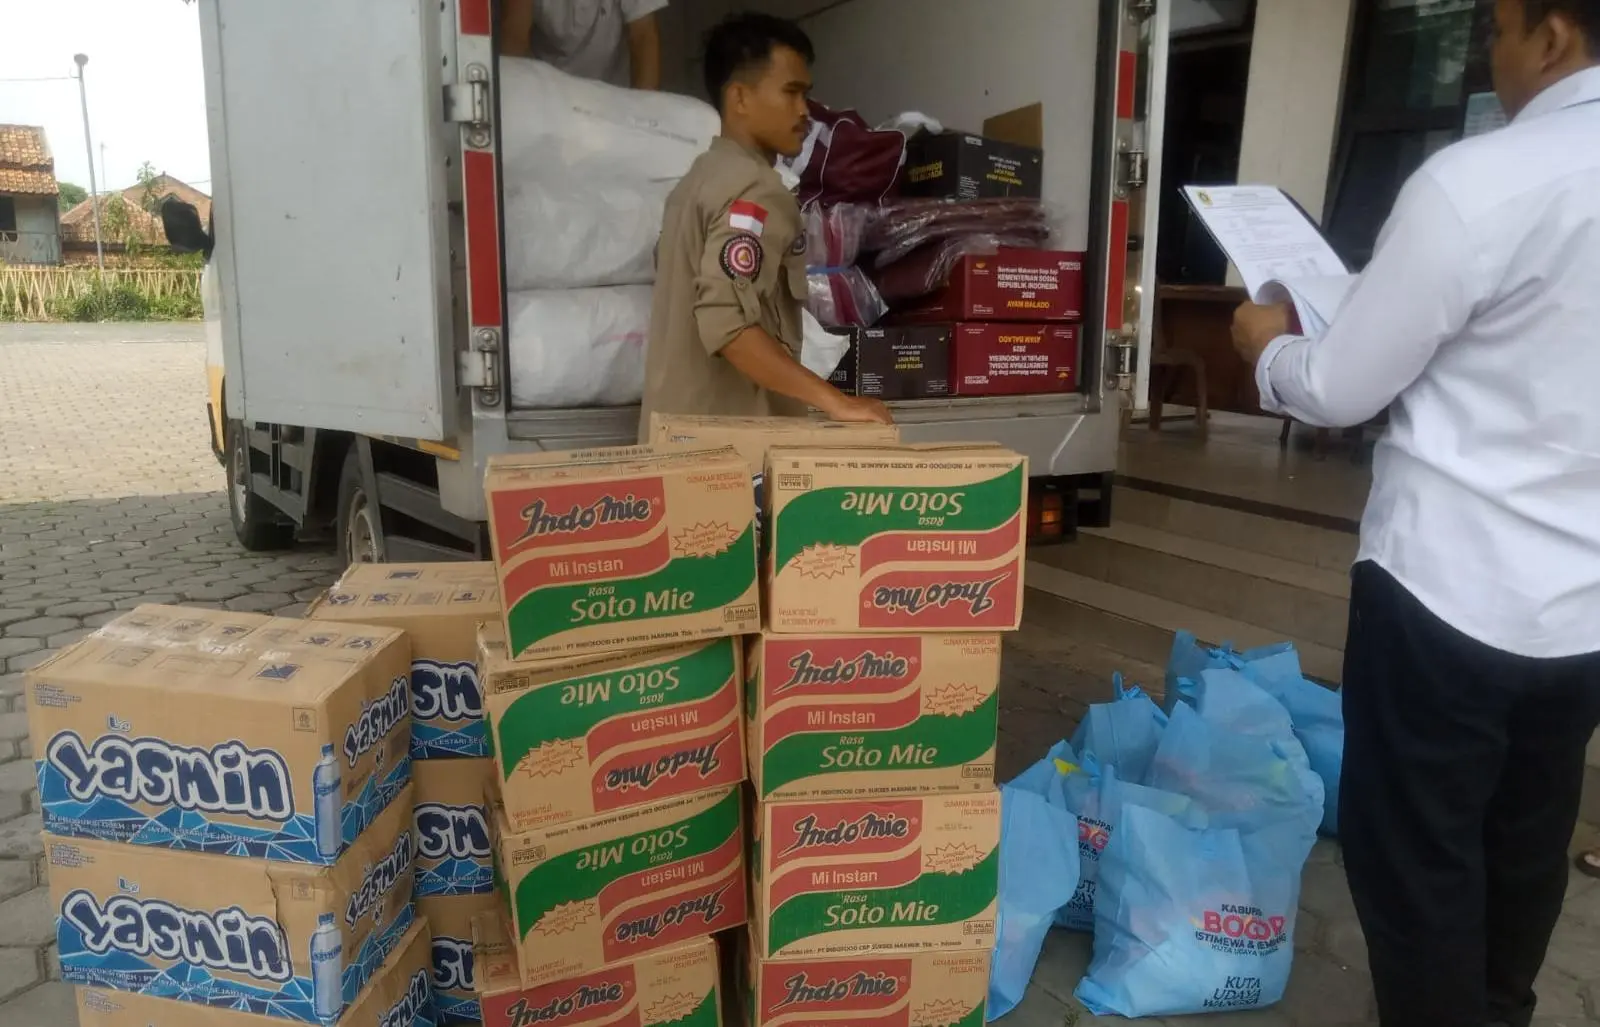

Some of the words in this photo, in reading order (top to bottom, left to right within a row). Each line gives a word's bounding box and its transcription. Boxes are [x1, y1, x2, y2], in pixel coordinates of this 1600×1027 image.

[1007, 300, 1023, 308] AYAM
[1024, 301, 1050, 309] BALADO
[840, 491, 891, 516] Mie
[900, 491, 966, 516] Soto
[918, 516, 945, 526] Rasa
[907, 540, 956, 554] Instan
[958, 540, 977, 554] Mi
[549, 561, 569, 577] Mi
[573, 557, 624, 575] Instan
[588, 584, 615, 597] Rasa
[570, 595, 637, 623] Soto
[643, 588, 695, 613] Mie
[619, 666, 681, 694] Soto
[560, 681, 611, 708] Mie
[639, 692, 665, 704] Rasa
[631, 713, 677, 732] Instan
[680, 710, 698, 724] Mi
[807, 711, 828, 725] Mi
[829, 710, 876, 724] Instan
[839, 736, 865, 746] Rasa
[819, 746, 881, 768] Soto
[887, 743, 938, 766] Mie
[631, 825, 691, 856] Soto
[575, 842, 625, 871] Mie
[649, 850, 673, 863] Rasa
[688, 861, 704, 873] Mi
[641, 864, 686, 888] Instan
[812, 871, 831, 885] Mi
[833, 870, 878, 884] Instan
[843, 893, 868, 904] Rasa
[824, 904, 885, 927] Soto
[891, 901, 939, 922] Mie
[1195, 931, 1245, 948] ISTIMEWA
[1225, 976, 1261, 989] KUTA
